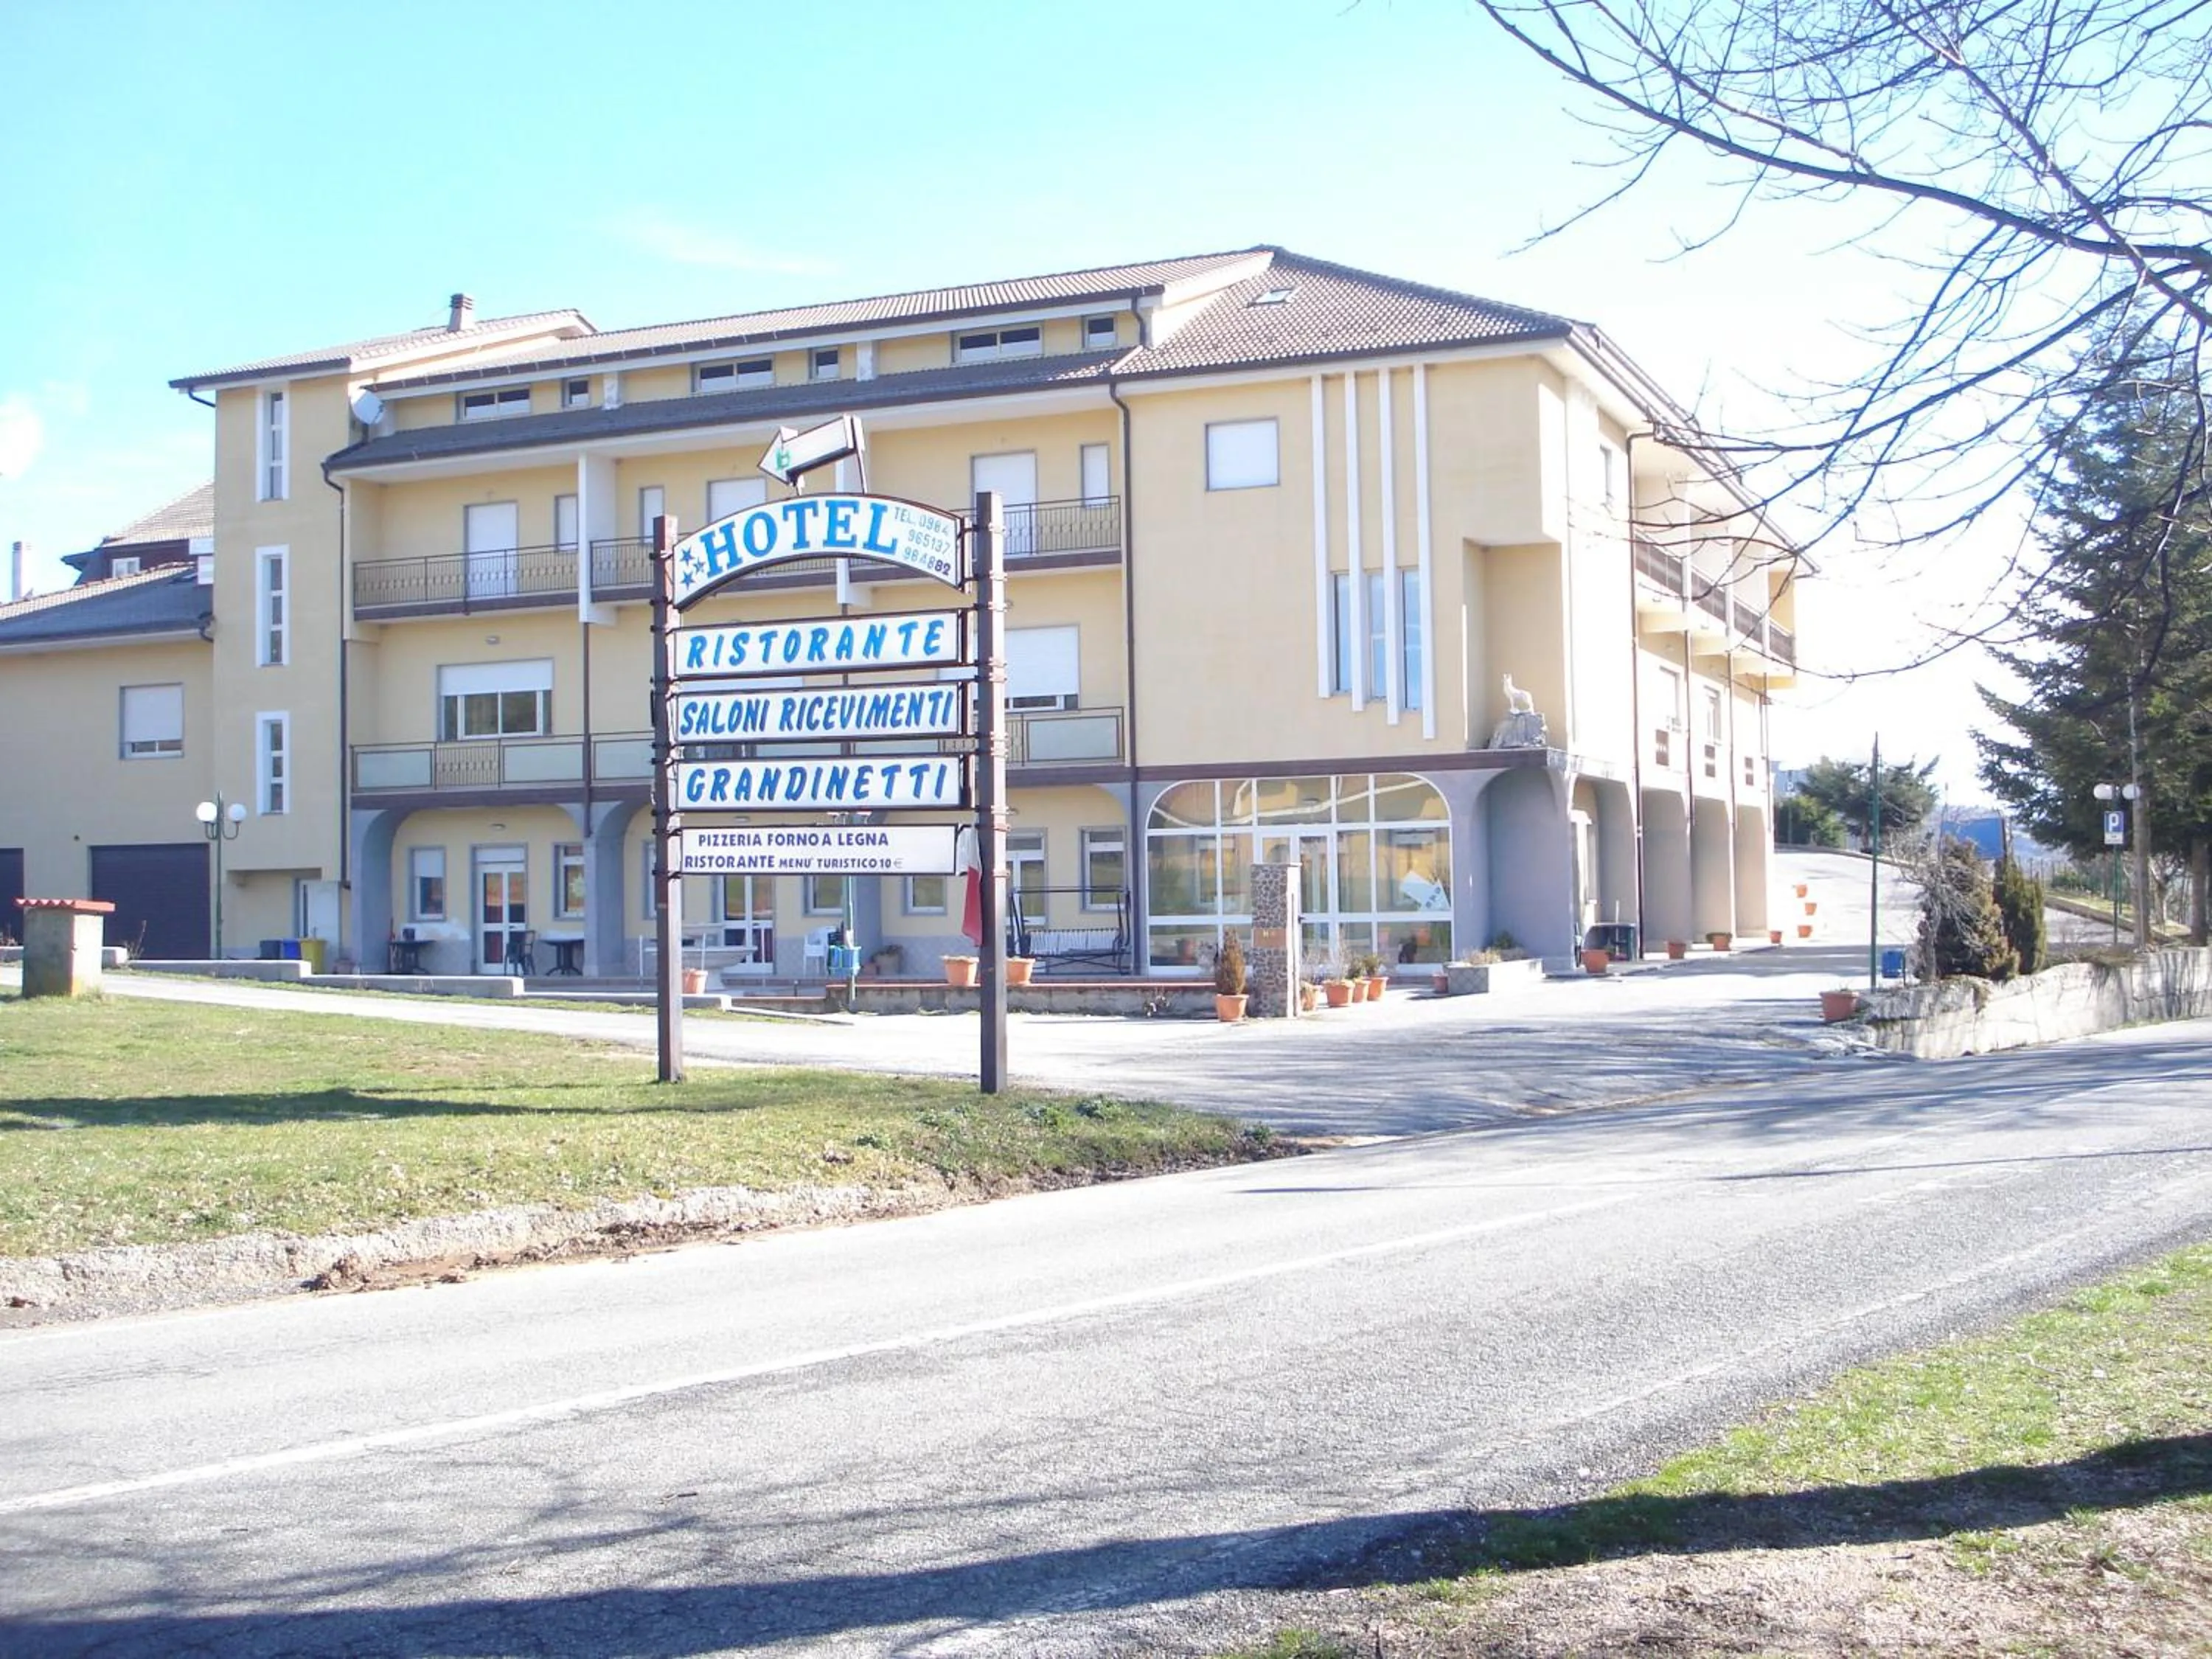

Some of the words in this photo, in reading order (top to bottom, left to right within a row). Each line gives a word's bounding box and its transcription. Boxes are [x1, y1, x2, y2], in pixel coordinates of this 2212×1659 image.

[700, 500, 897, 577] HOTEL
[686, 619, 945, 669] RISTORANTE
[680, 698, 770, 734] SALONI
[779, 691, 954, 732] RICEVIMENTI
[686, 763, 947, 802] GRANDINETTI
[698, 833, 762, 847] PIZZERIA
[768, 832, 819, 846] FORNO
[821, 832, 832, 846] A
[838, 832, 888, 846] LEGNA
[2109, 813, 2119, 832] P
[684, 855, 775, 869] RISTORANTE
[816, 858, 877, 869] TURISTICO
